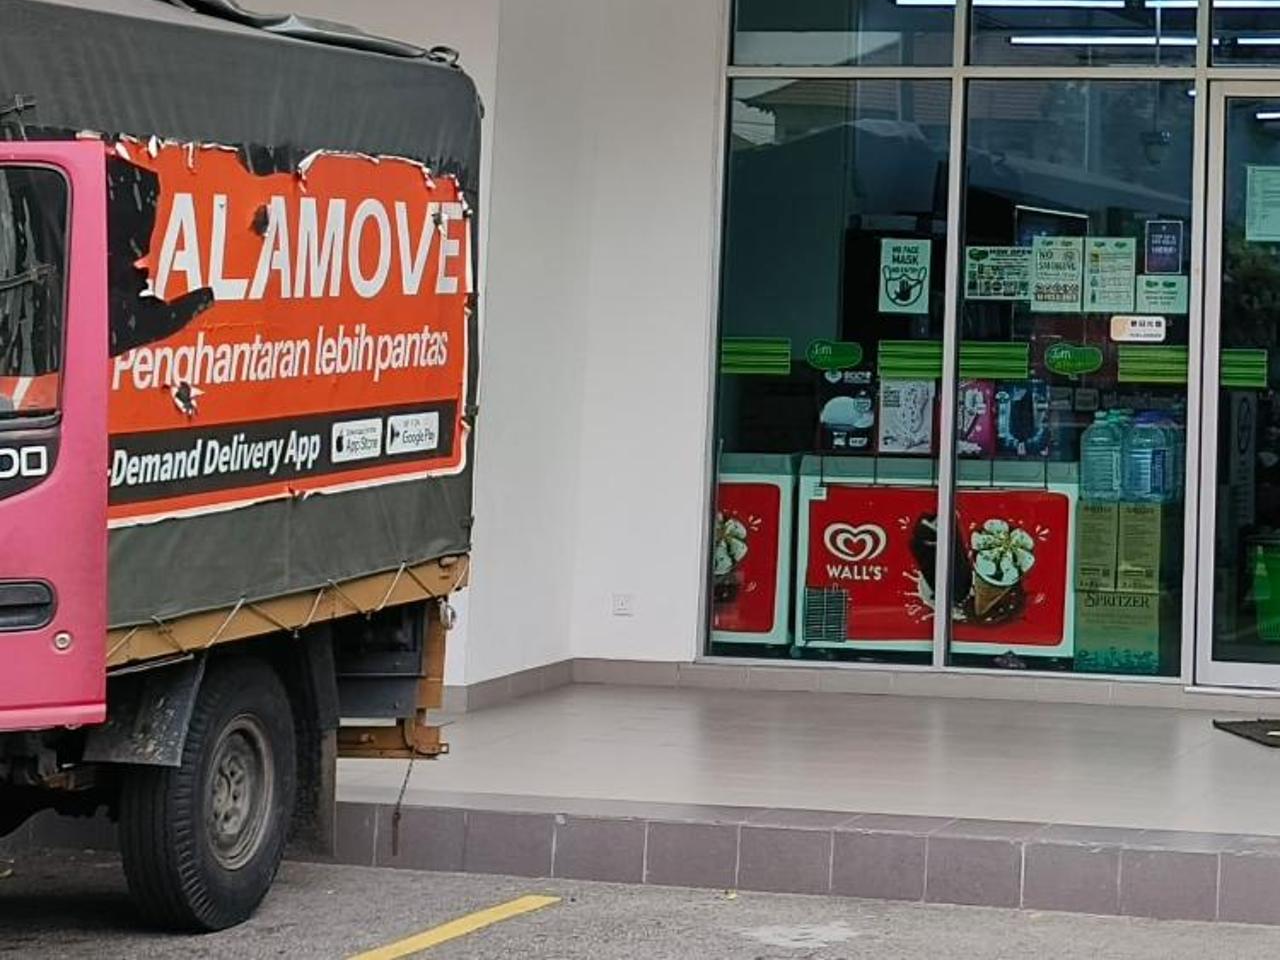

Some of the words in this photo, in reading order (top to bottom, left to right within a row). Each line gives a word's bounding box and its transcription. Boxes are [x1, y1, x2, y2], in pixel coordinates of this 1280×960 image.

[315, 323, 375, 376] lebih
[373, 325, 449, 383] pantas
[204, 429, 284, 476] Delivery
[284, 430, 322, 471] App
[826, 564, 881, 580] WALL'S
[1084, 594, 1151, 608] SPRITZER
